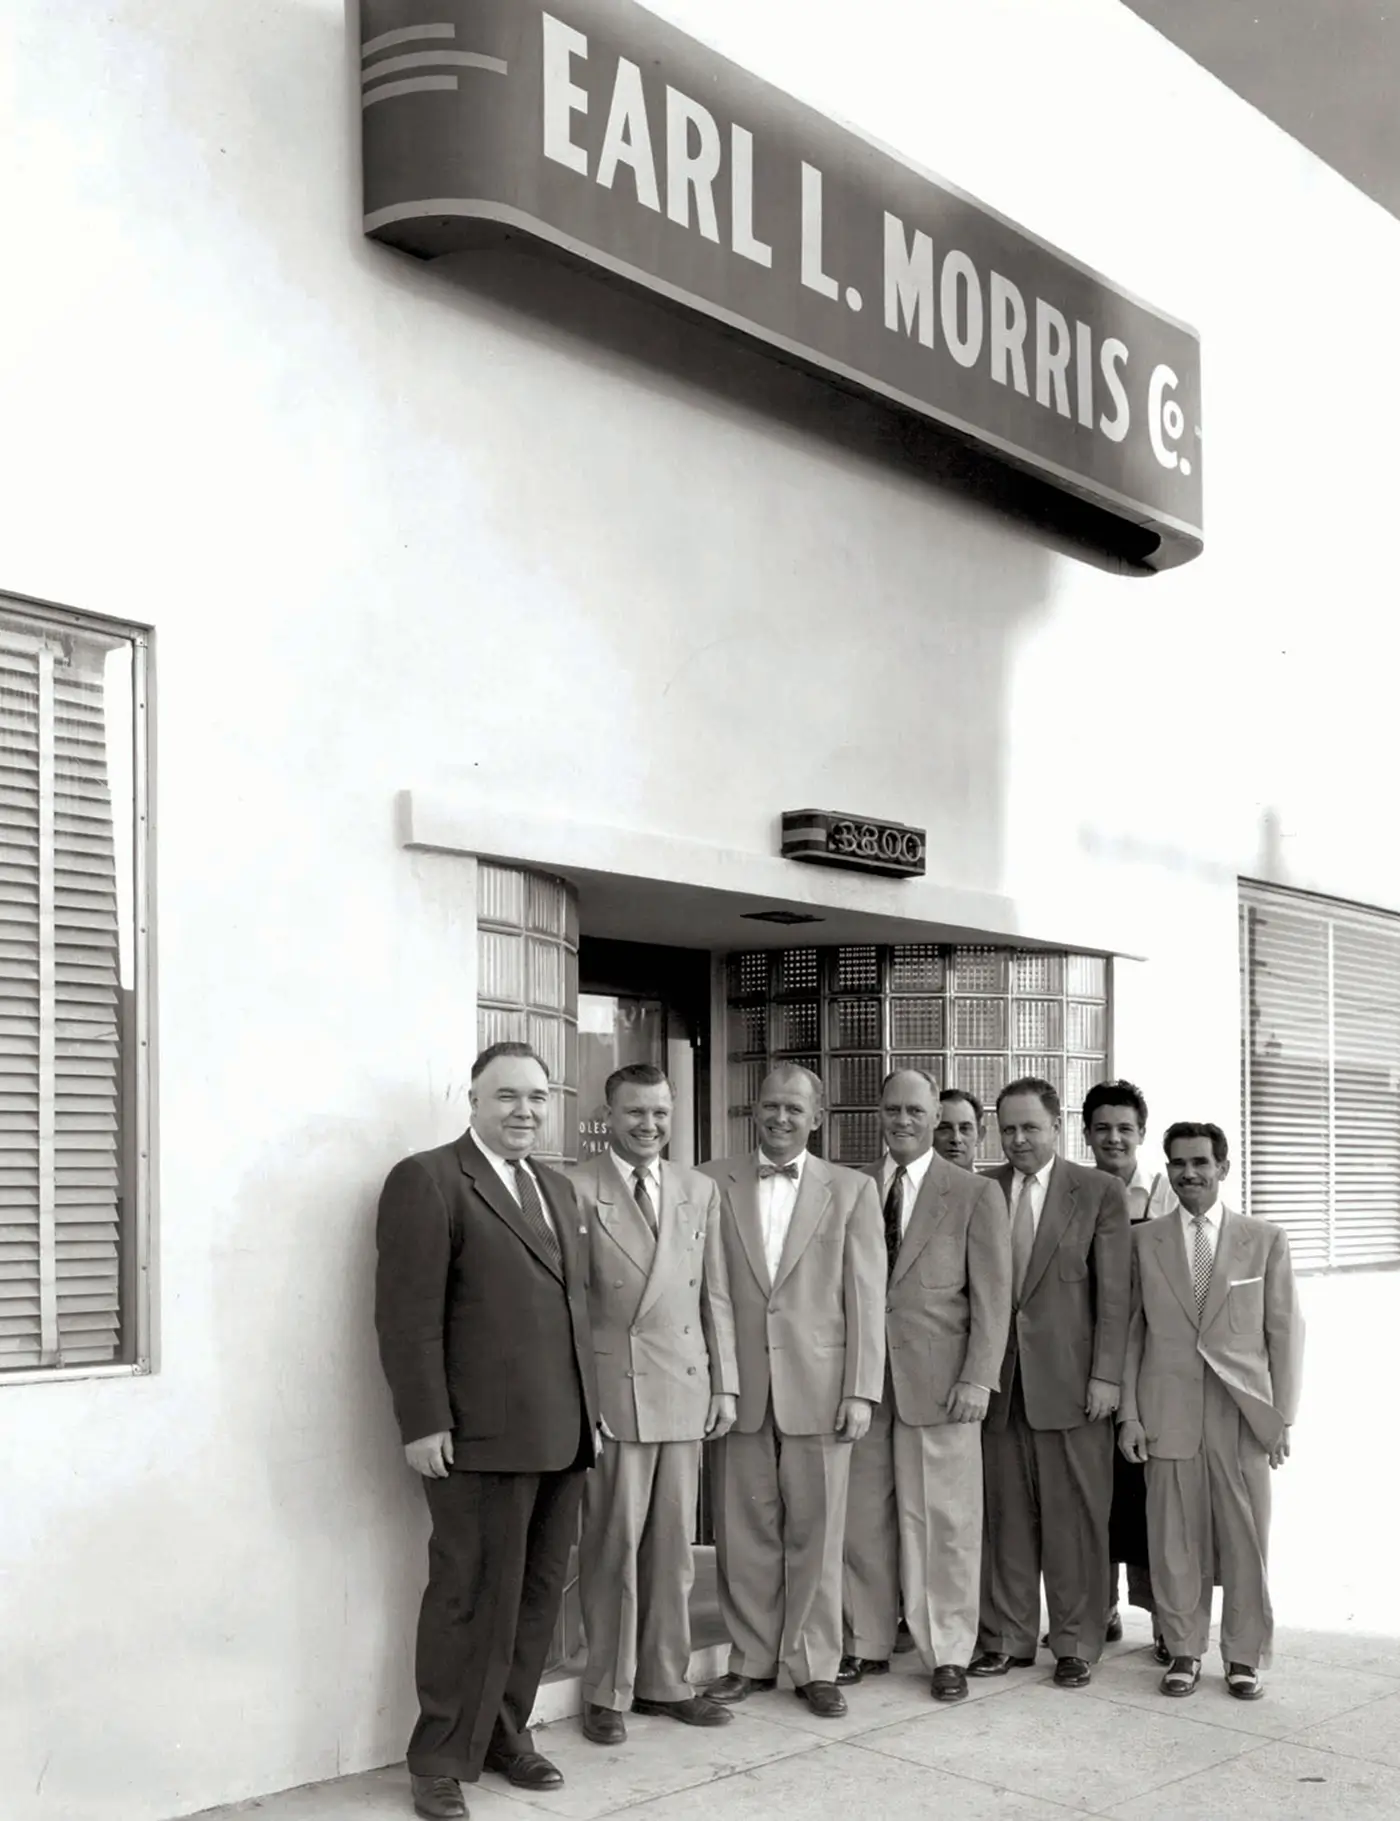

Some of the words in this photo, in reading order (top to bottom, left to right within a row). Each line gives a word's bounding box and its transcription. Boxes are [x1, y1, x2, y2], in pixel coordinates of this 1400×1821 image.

[542, 11, 773, 269] EARL
[802, 160, 865, 313] L.
[884, 210, 1131, 443] MORRIS
[579, 1121, 612, 1134] OLES
